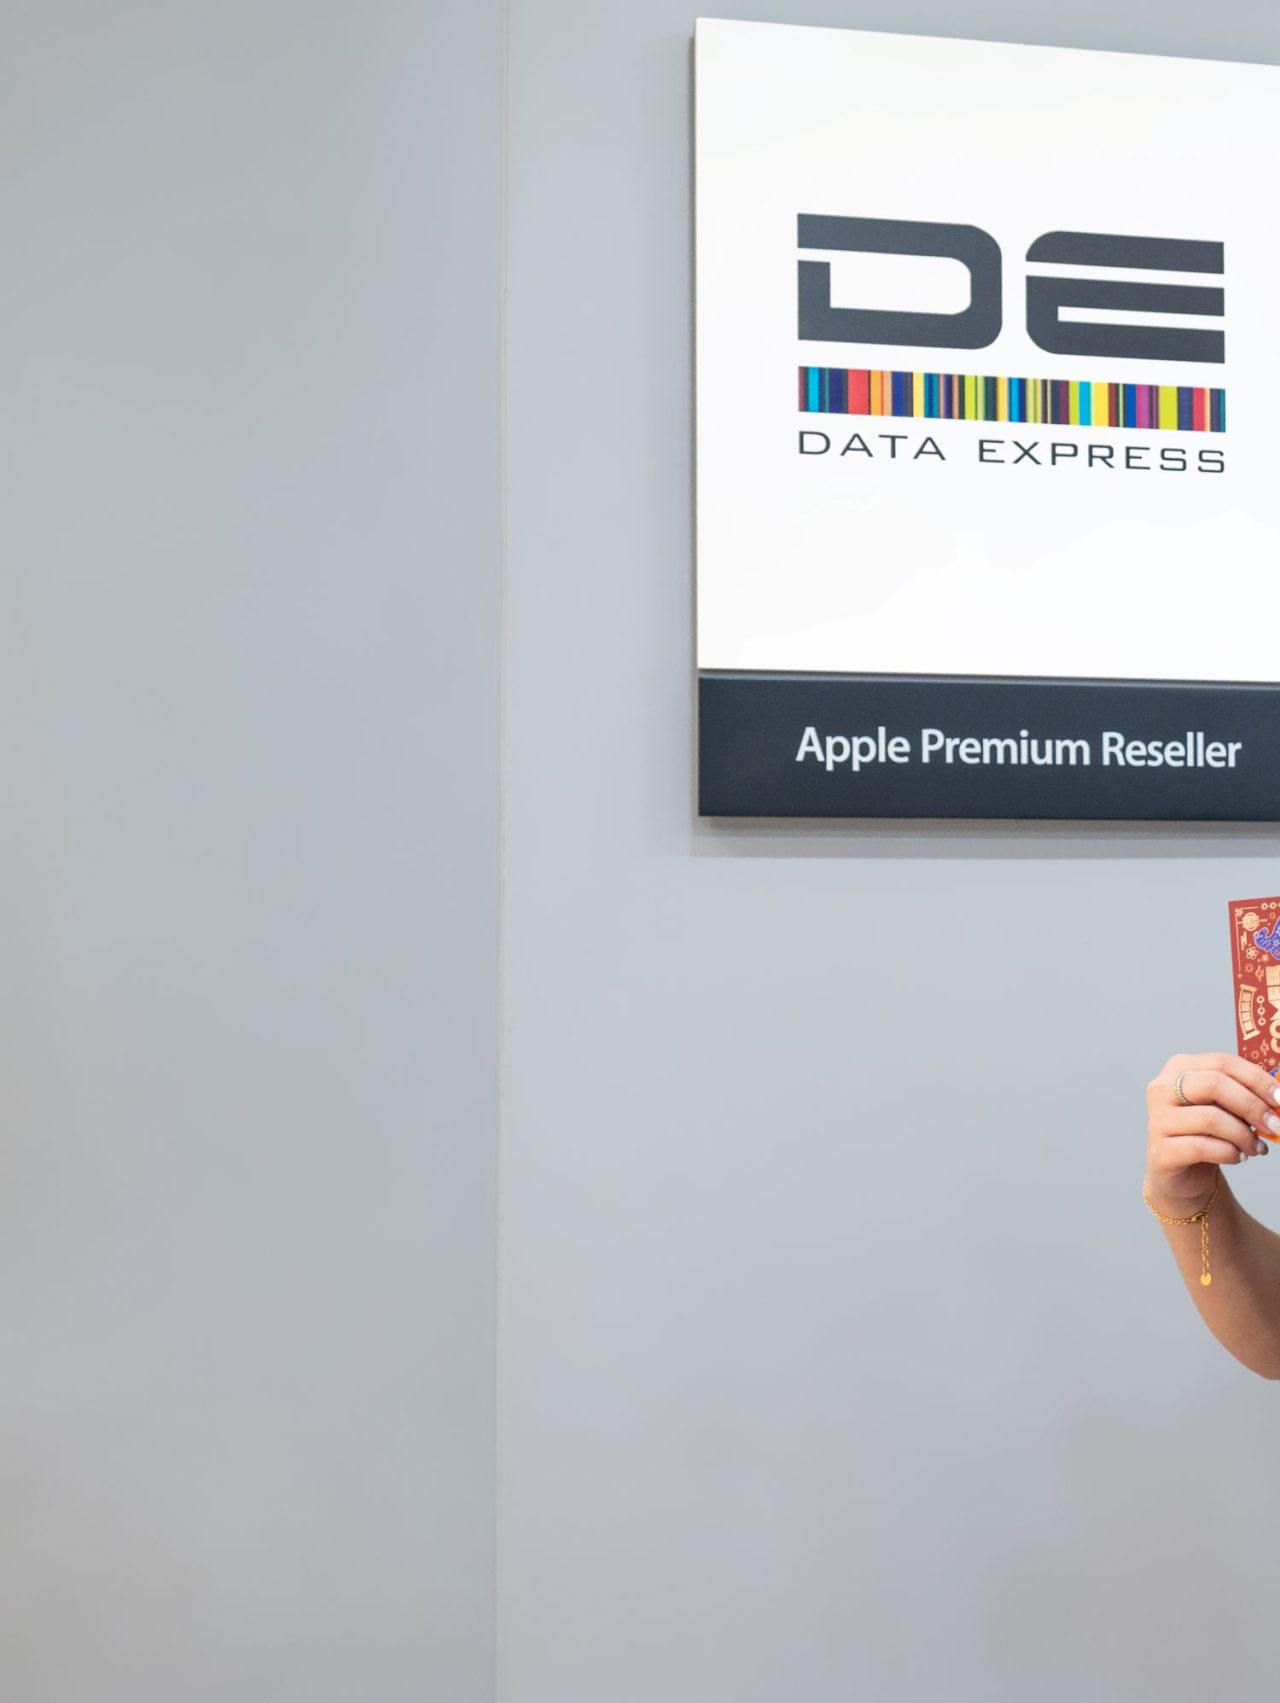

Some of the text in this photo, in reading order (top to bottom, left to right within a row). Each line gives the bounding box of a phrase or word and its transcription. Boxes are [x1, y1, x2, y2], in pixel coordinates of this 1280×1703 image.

[797, 212, 1226, 364] DE
[797, 429, 1227, 475] DATA EXPRESS
[795, 725, 1243, 774] Apple Premium Reseller
